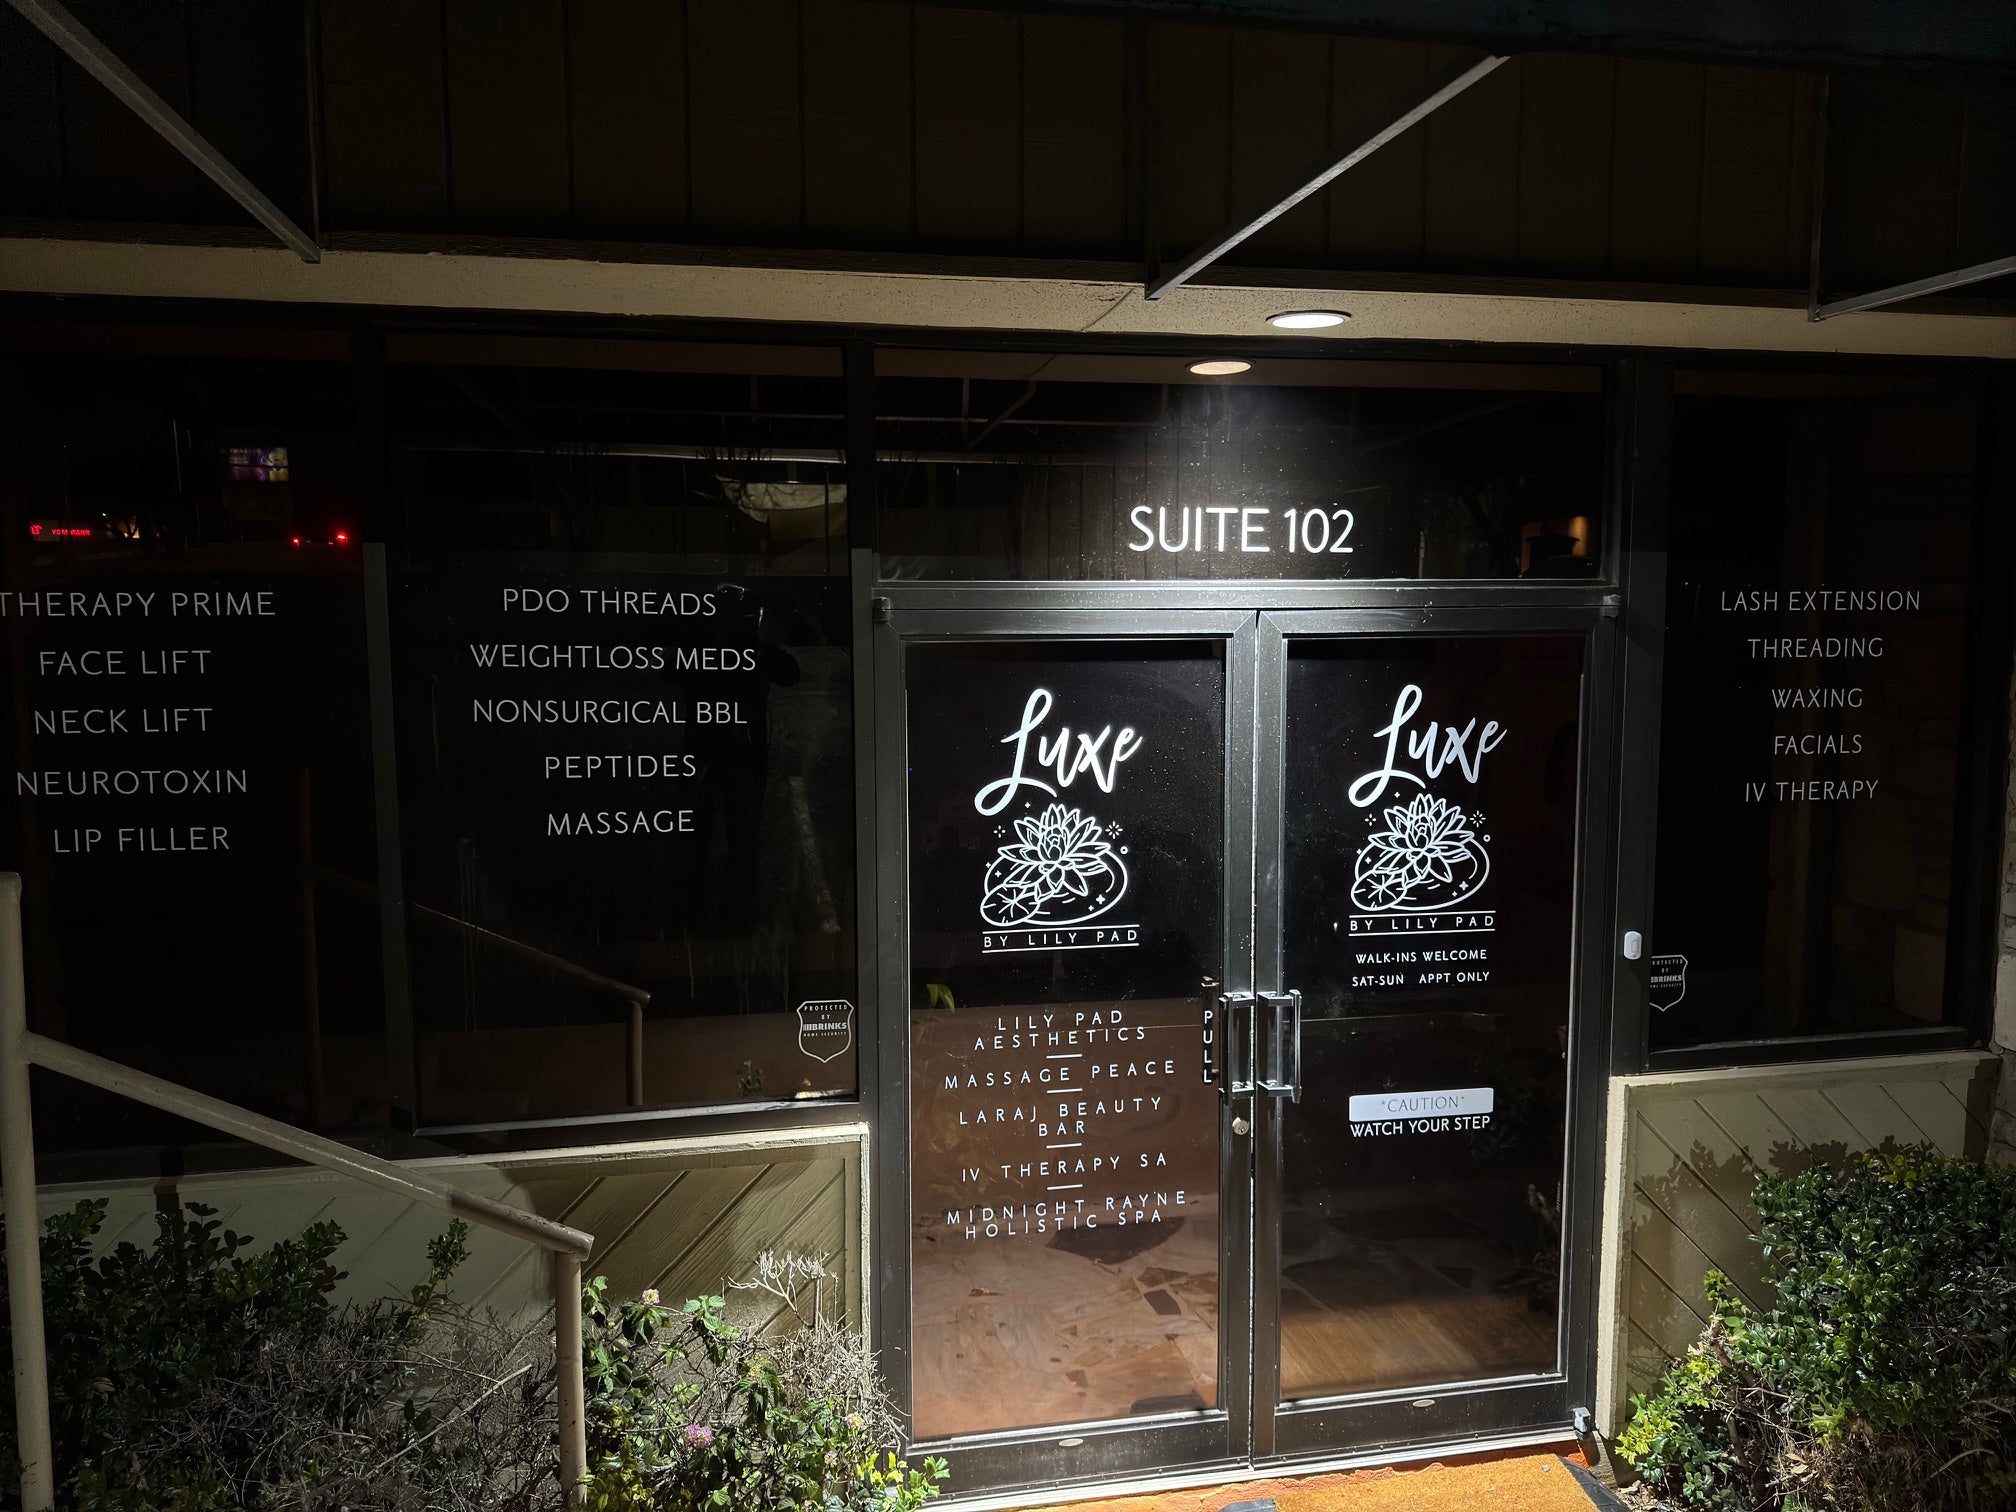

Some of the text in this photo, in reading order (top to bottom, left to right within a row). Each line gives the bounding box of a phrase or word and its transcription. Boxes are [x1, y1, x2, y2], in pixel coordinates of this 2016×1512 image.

[1129, 505, 1354, 554] SUITE 102
[0, 591, 276, 617] THERAPY PRIME
[503, 588, 716, 616] PDO THREADS
[1721, 590, 1920, 612] LASH EXTENSION
[470, 644, 756, 671] WEIGHTLOSS MEDS
[1747, 637, 1884, 659] THREADING
[39, 650, 212, 676] FACE LIFT
[1771, 688, 1863, 709] WAXING
[34, 708, 213, 735] NECK LIFT
[473, 699, 748, 724] NONSURGICAL BBL
[974, 687, 1143, 817] Luxe
[1348, 684, 1508, 808] Luxe
[1774, 734, 1863, 756] FACIALS
[545, 755, 697, 779] PEPTIDES
[17, 769, 247, 796] NEUROTOXIN
[1745, 779, 1879, 802] IV THERAPY
[547, 809, 695, 836] MASSAGE
[54, 826, 230, 853] LIP FILLER
[1350, 915, 1494, 932] BY LILY PAD
[983, 930, 1139, 948] BY LILY PAD
[1355, 949, 1487, 965] WALK-INS WELCOME
[1352, 971, 1490, 987] SAT-SUN APPT ONLY
[804, 1004, 848, 1012] PROTECTED
[998, 1010, 1124, 1031] LILY PAD
[812, 1022, 847, 1031] BRINKS
[975, 1026, 1146, 1051] AESTHETICS
[1202, 1010, 1214, 1084] PULL
[944, 1060, 1175, 1090] MASSAGE PEACE
[959, 1097, 1162, 1125] LARAJ BEAUTY
[1039, 1119, 1085, 1138] BAR
[1350, 1115, 1491, 1138] WATCH YOUR STEP
[962, 1152, 1168, 1183] IV THERAPY SA
[947, 1190, 1186, 1225] MIDNIGHT RAYNE
[966, 1209, 1161, 1240] HOLISTIC SPA
